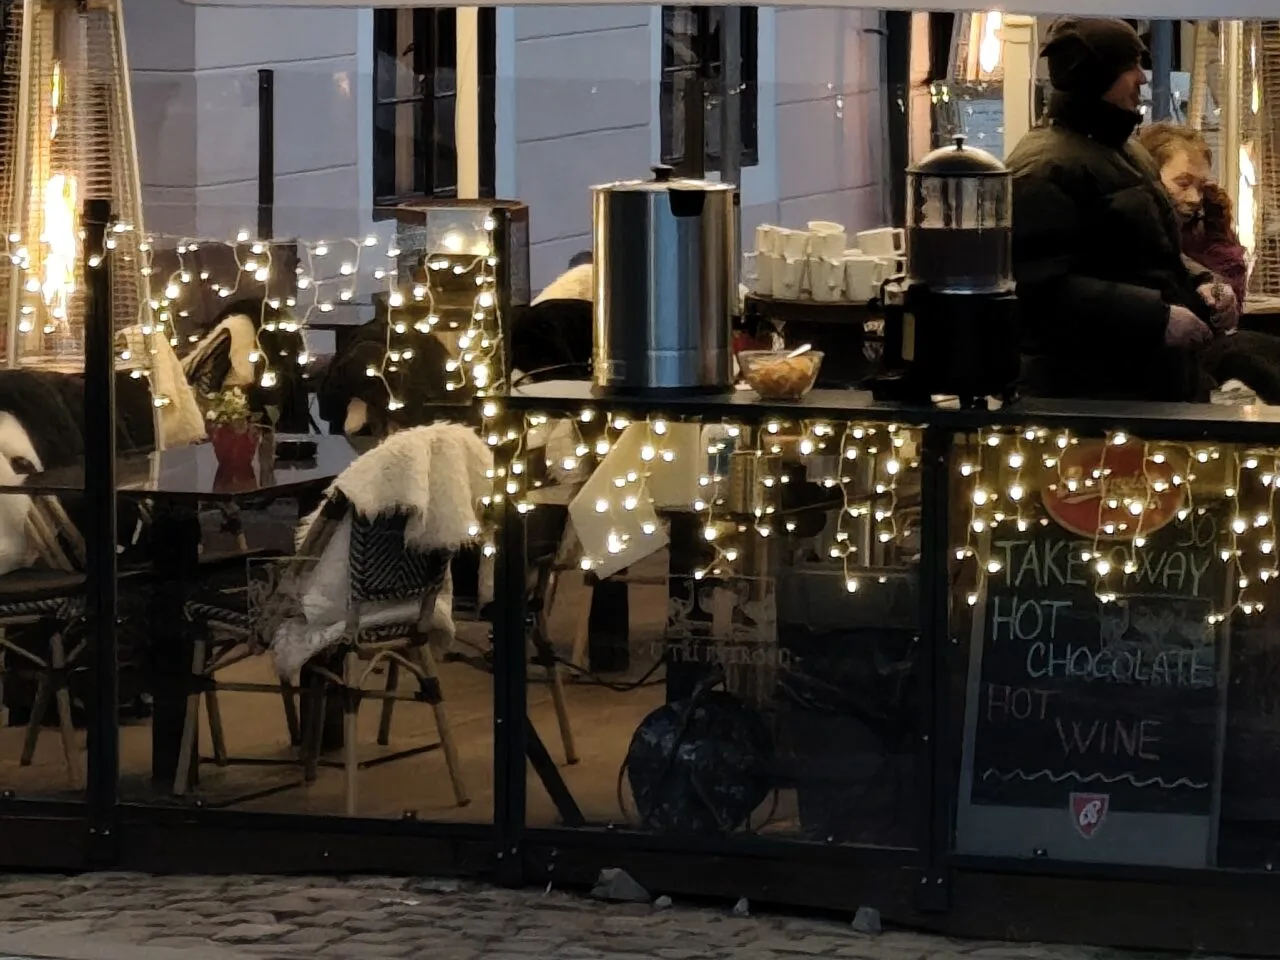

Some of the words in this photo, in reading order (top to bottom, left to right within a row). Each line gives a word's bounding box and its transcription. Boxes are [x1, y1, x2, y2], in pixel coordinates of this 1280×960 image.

[994, 538, 1087, 589] TAKE
[991, 594, 1073, 641] HOT
[1026, 640, 1214, 689] CHOCOLATE
[986, 682, 1063, 723] HOT
[1053, 716, 1163, 761] WINE
